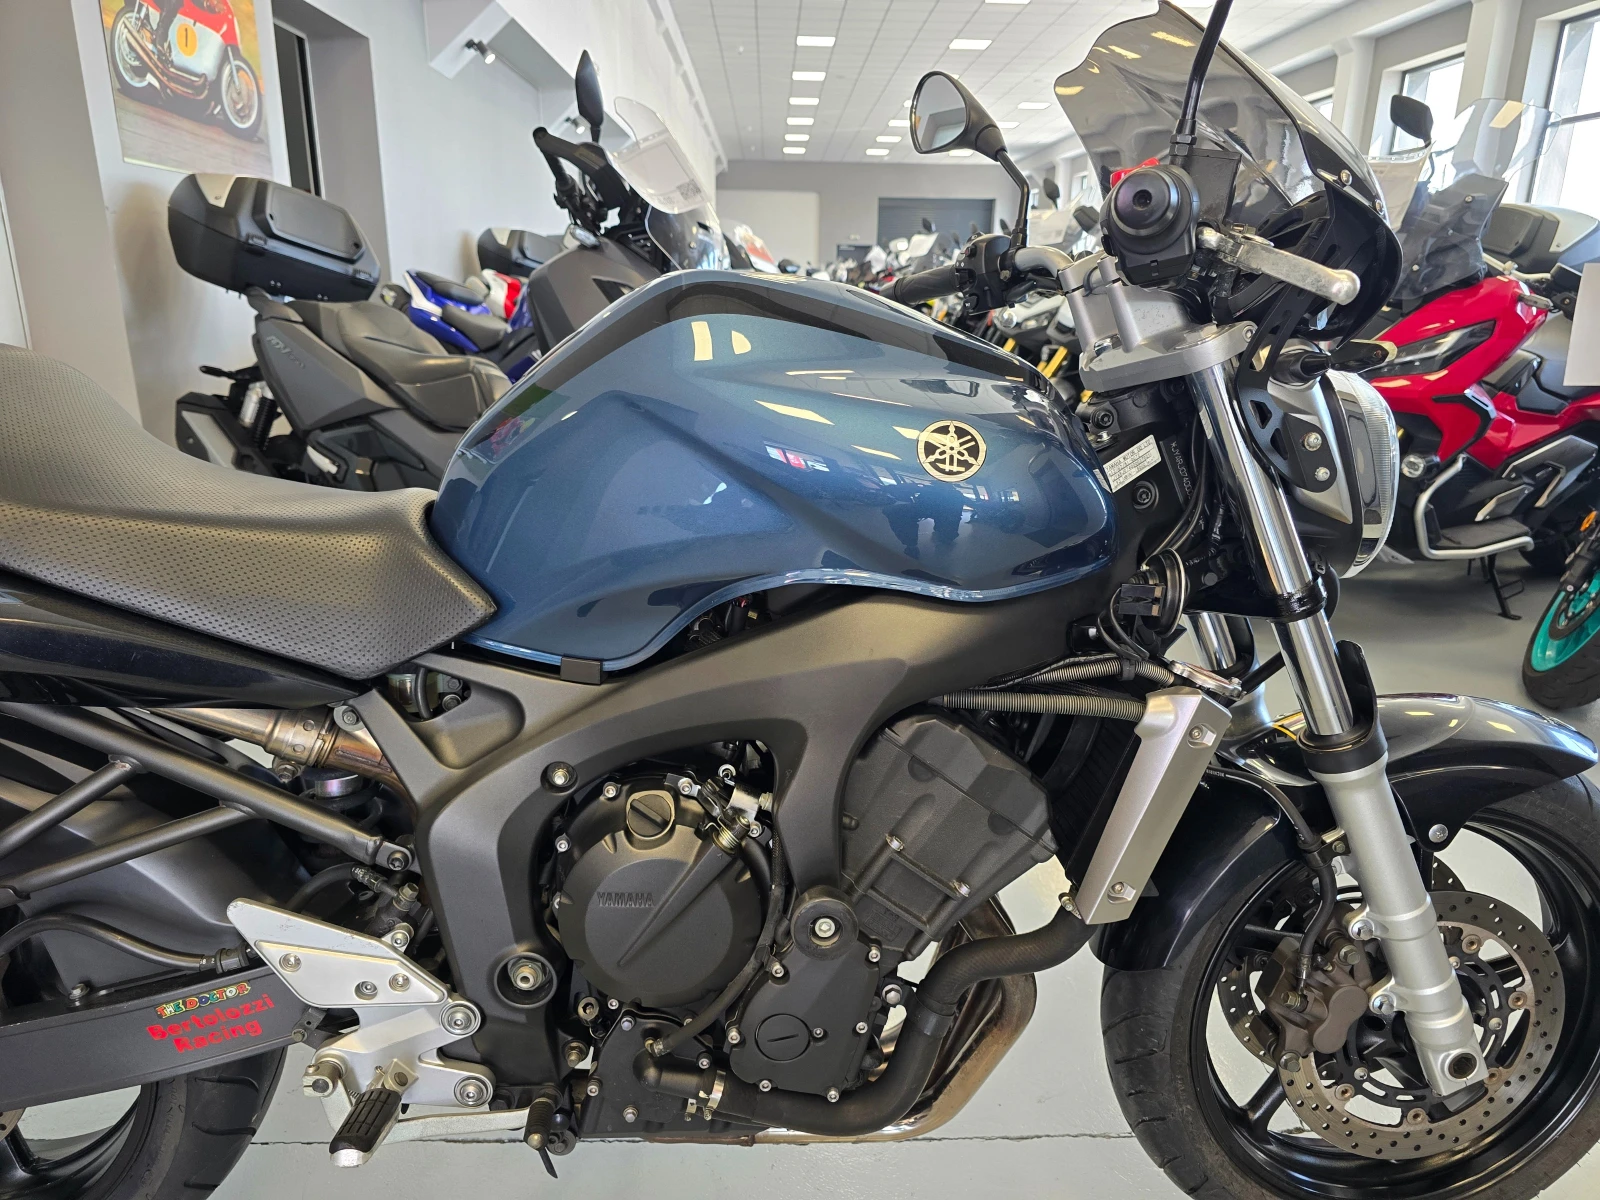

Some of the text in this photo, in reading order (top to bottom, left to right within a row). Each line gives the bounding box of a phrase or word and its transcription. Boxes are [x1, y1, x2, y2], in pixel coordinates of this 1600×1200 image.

[597, 892, 655, 908] YAMAHA
[146, 993, 275, 1041] Bertolozzi
[156, 982, 251, 1018] THE DOCTOR
[173, 1020, 263, 1053] Racing
